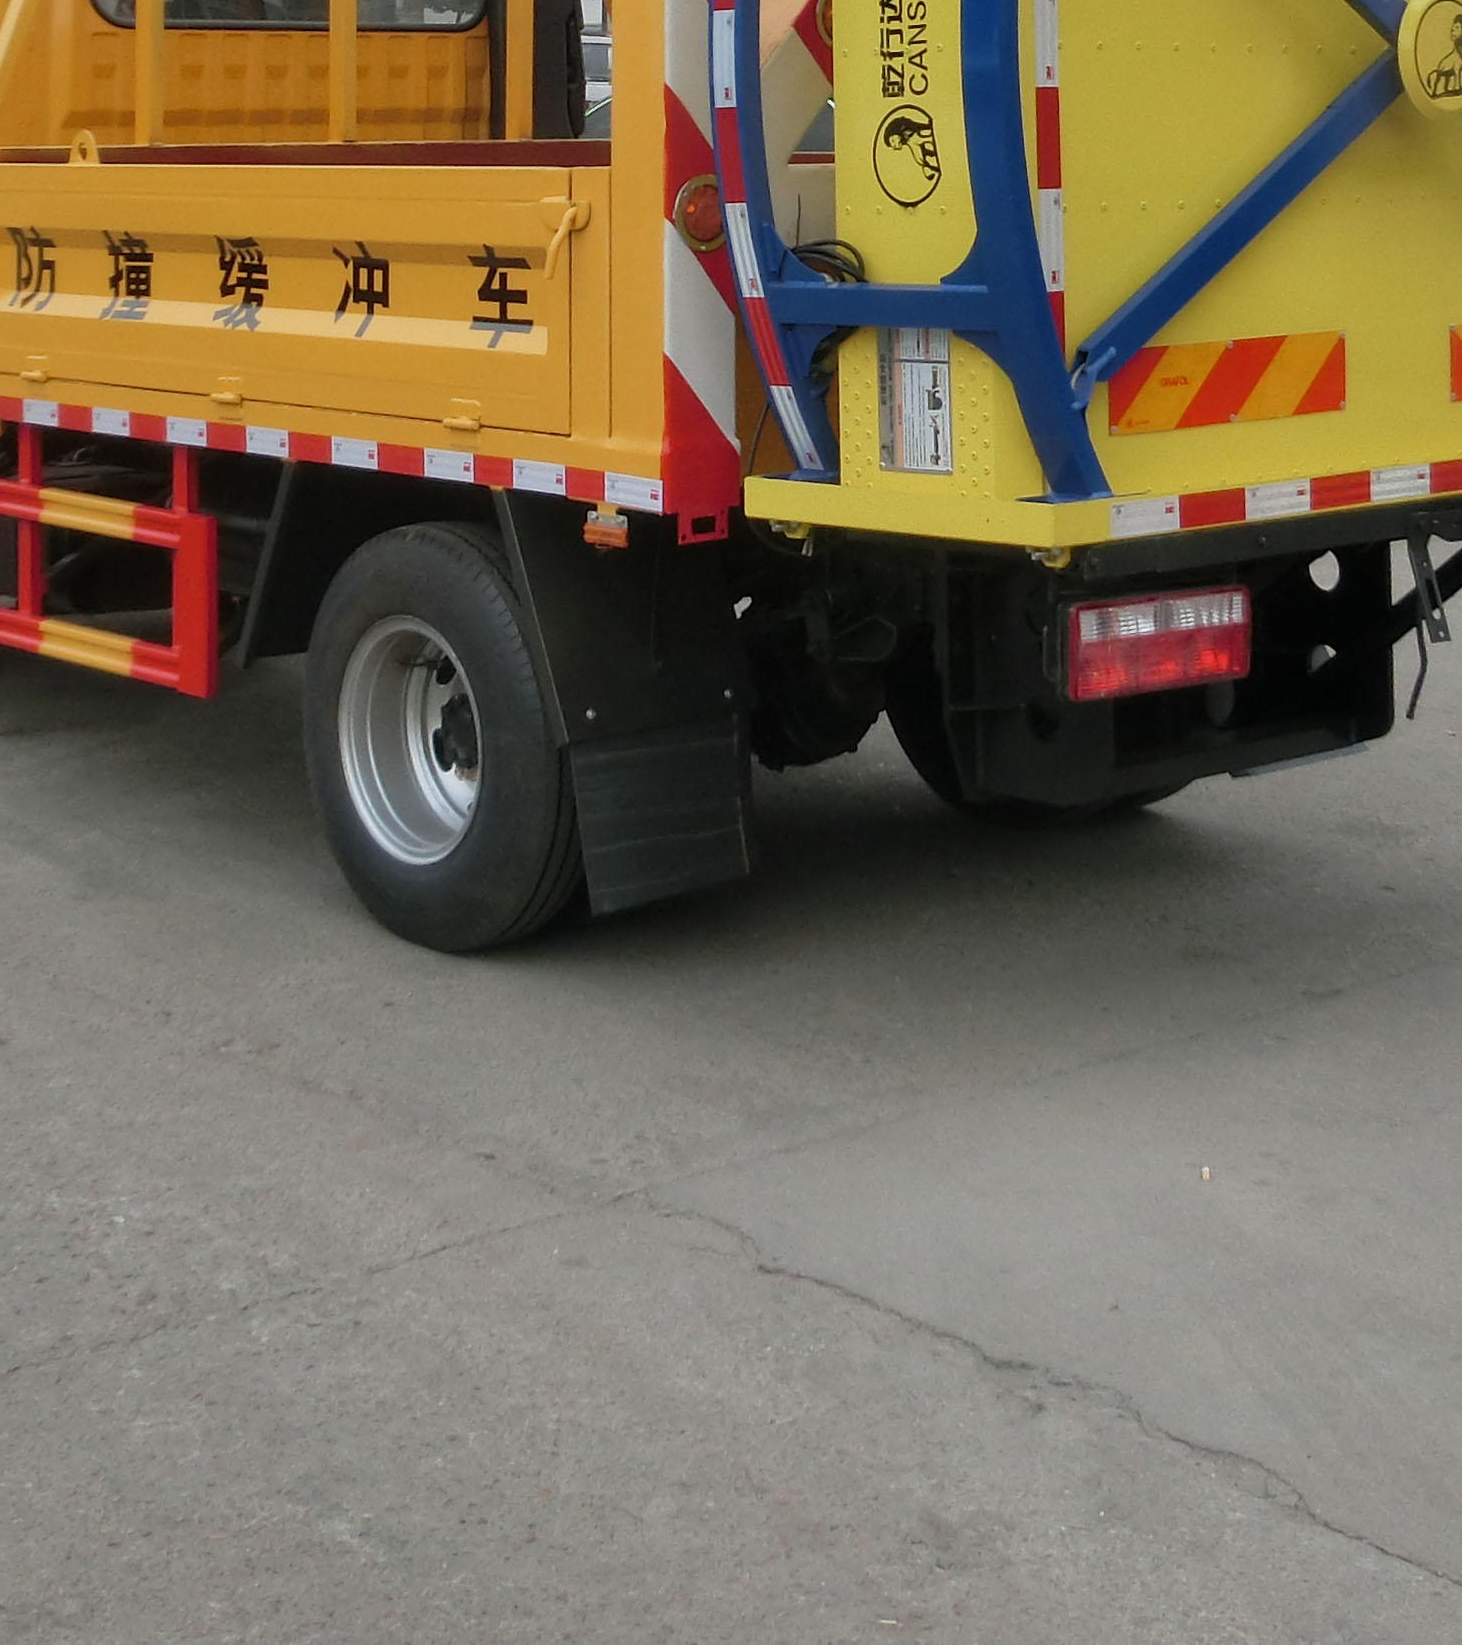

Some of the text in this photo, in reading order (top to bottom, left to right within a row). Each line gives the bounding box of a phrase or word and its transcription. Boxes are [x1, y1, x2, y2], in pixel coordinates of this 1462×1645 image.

[7, 225, 535, 350] 防撞缓冲车
